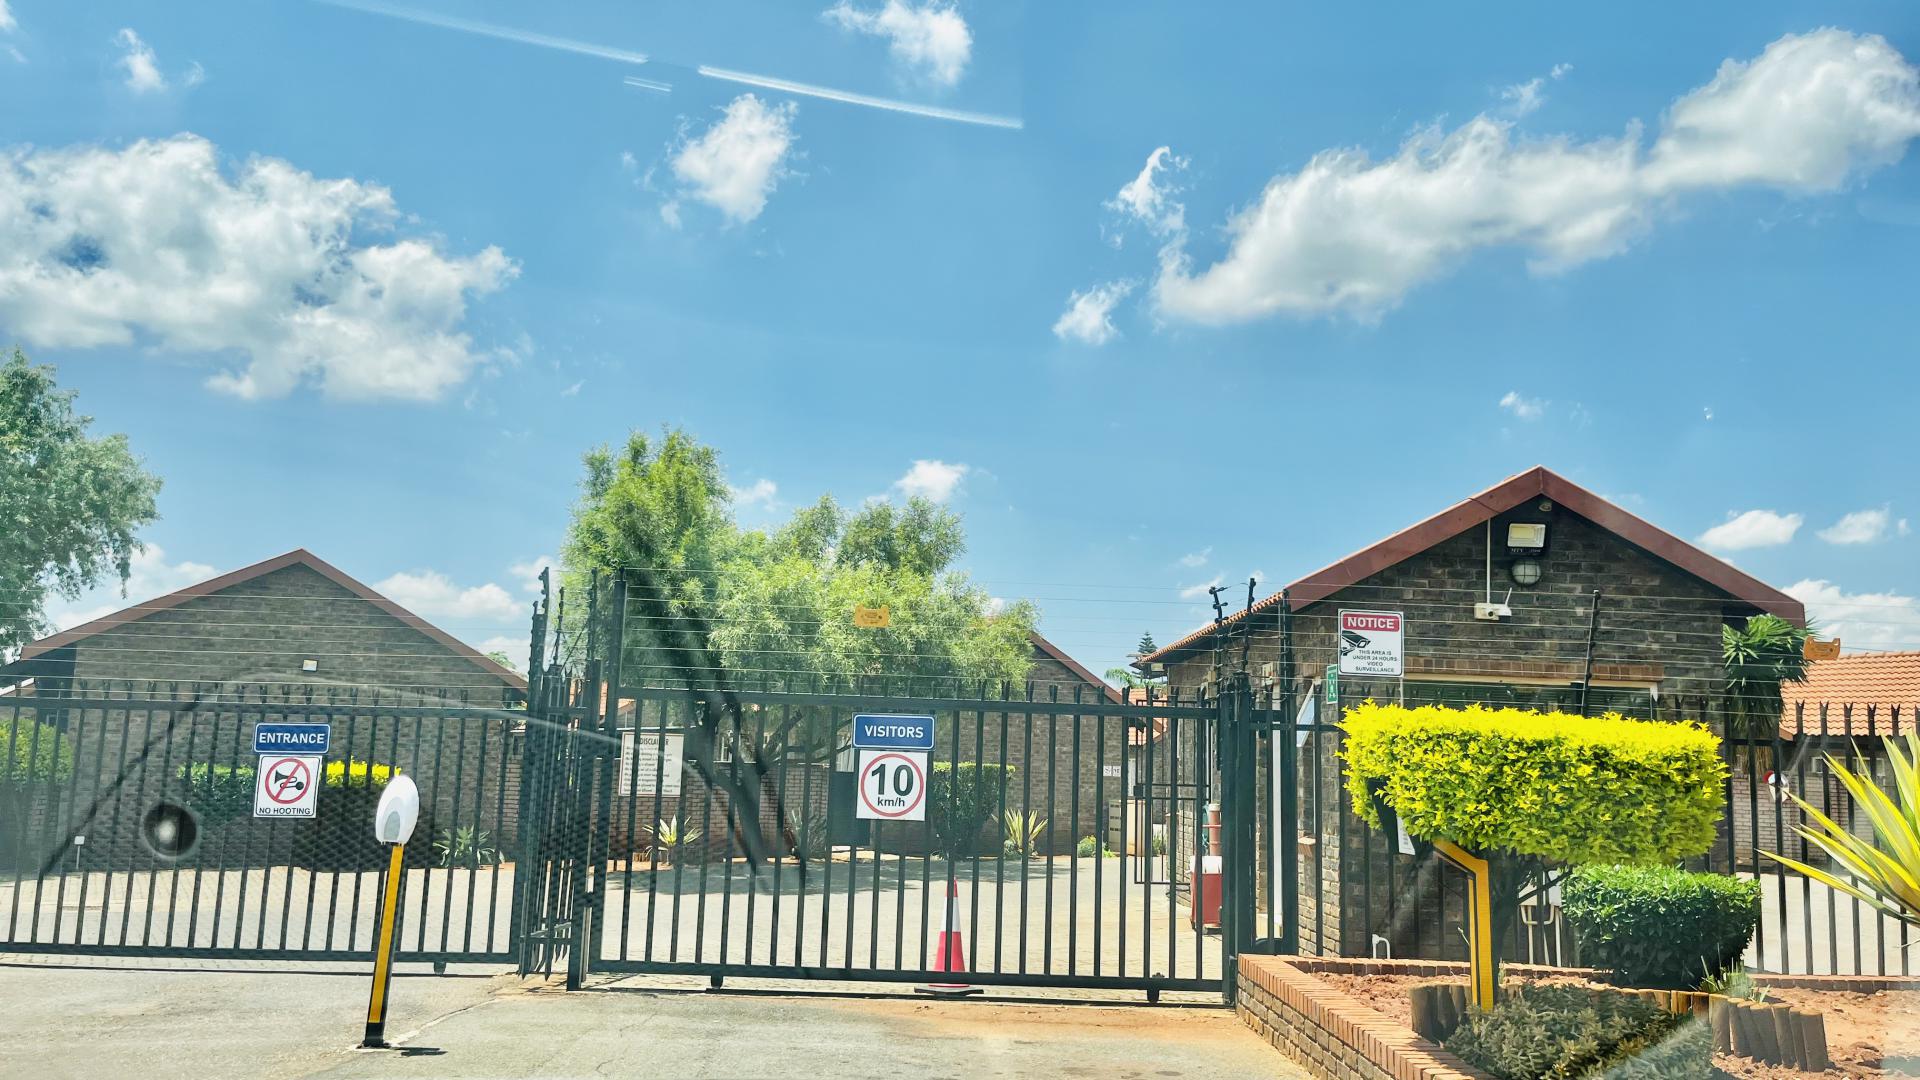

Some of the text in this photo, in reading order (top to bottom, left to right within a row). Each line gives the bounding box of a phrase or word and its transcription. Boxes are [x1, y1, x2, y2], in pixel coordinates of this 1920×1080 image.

[1347, 616, 1395, 629] NOTICE
[865, 725, 924, 738] VISITORS
[259, 732, 325, 744] ENTRANCE
[639, 737, 669, 745] DISCLAIR
[871, 763, 914, 797] 10
[877, 796, 905, 807] km/h
[273, 807, 311, 815] HOOTING
